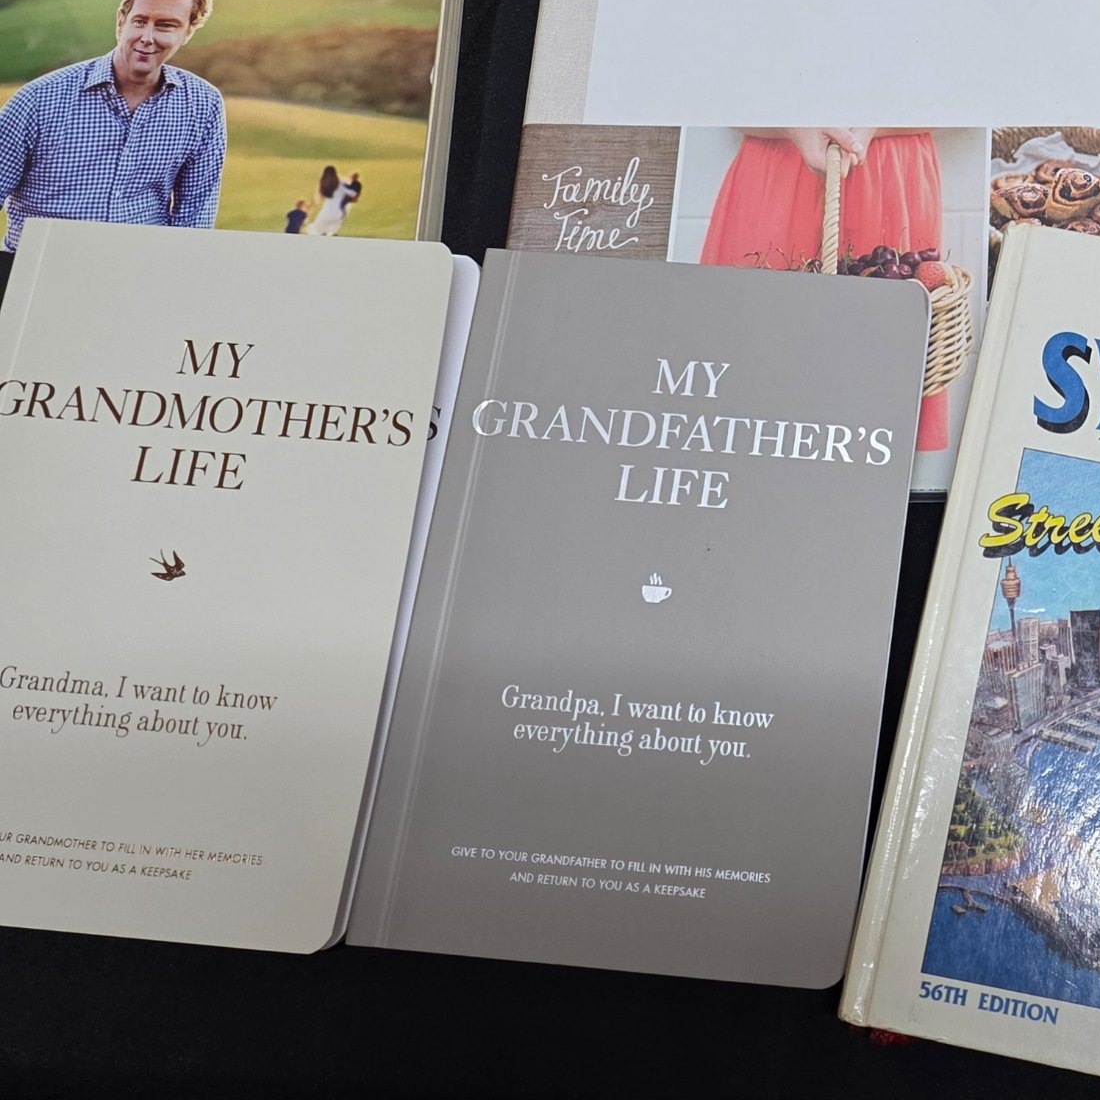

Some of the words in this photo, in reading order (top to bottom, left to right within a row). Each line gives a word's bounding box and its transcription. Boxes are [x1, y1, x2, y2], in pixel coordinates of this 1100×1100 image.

[542, 156, 654, 228] Family
[553, 209, 638, 253] Time
[175, 339, 254, 379] MY
[651, 358, 731, 399] MY
[0, 379, 415, 447] GRANDMOTHER'S
[472, 399, 894, 467] GRANDFATHER'S
[131, 446, 247, 490] LIFE
[614, 464, 730, 510] LIFE
[0, 666, 109, 699] Grandma,
[116, 676, 129, 698] I
[133, 679, 186, 704] want
[192, 684, 210, 705] to
[215, 685, 278, 711] know
[501, 685, 605, 723] Grandpa,
[611, 694, 623, 717] I
[627, 698, 682, 722] want
[687, 702, 706, 723] to
[711, 702, 774, 729] know
[12, 703, 131, 738] everything
[137, 710, 200, 736] about
[196, 720, 248, 748] you.
[513, 721, 634, 757] everything
[639, 728, 702, 754] about
[699, 741, 751, 765] you.
[451, 846, 477, 859] GIVE
[480, 848, 495, 860] TO
[498, 850, 528, 863] YOUR
[531, 852, 607, 870] GRANDFATHER
[610, 858, 625, 871] TO
[627, 860, 646, 874] FILL
[649, 862, 661, 875] IN
[665, 863, 692, 877] WITH
[695, 866, 712, 879] HIS
[714, 867, 771, 884] MEMORIES
[509, 871, 534, 884] AND
[537, 873, 577, 888] RETURN
[580, 877, 595, 889] TO
[599, 879, 622, 892] YOU
[625, 881, 640, 893] AS
[642, 883, 651, 894] A
[654, 884, 706, 899] KEEPSAKE
[918, 980, 967, 1007] 56TH
[977, 993, 1059, 1026] EDITION
